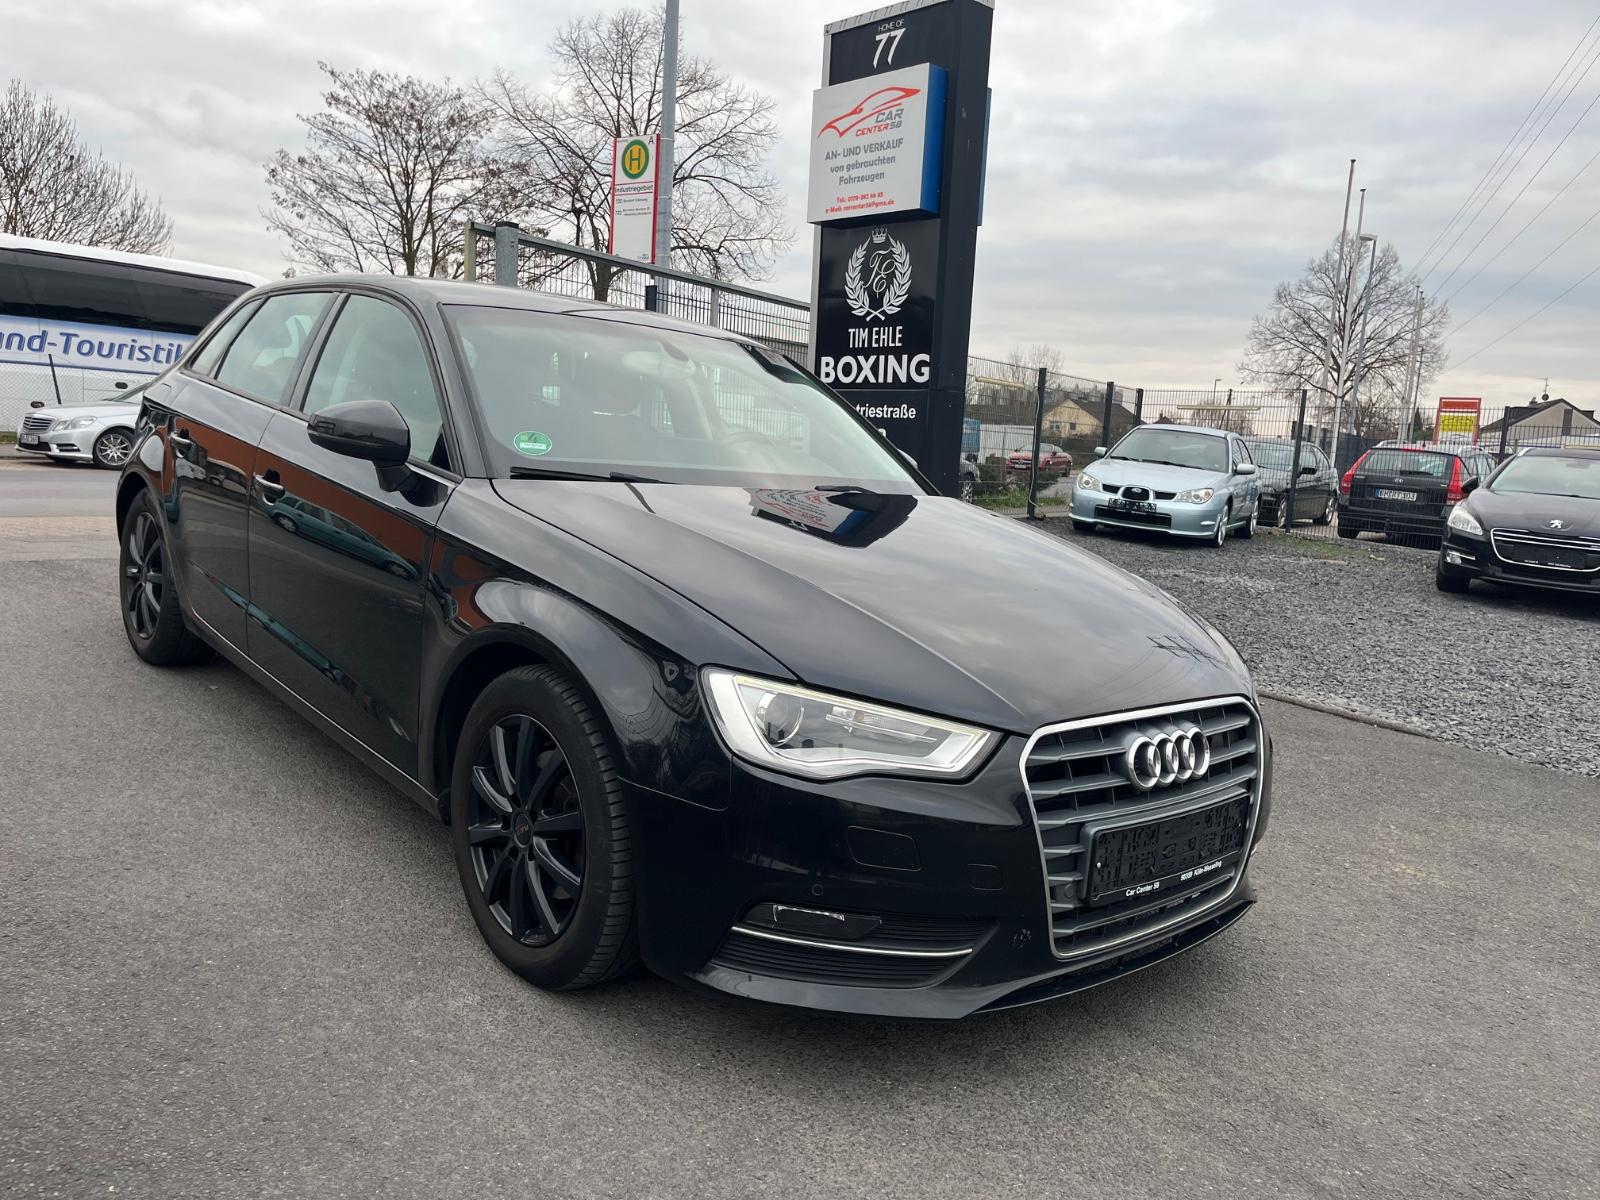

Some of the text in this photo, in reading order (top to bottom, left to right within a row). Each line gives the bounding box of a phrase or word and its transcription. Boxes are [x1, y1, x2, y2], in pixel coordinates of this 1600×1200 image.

[879, 18, 905, 32] HOME OF
[872, 28, 906, 69] 77
[875, 108, 905, 124] CAR
[648, 135, 655, 145] A
[824, 137, 904, 161] AN- UND VERKAUF
[629, 148, 642, 171] H
[830, 155, 896, 173] von gebrauchten
[838, 172, 885, 186] Fahrzeugen
[848, 325, 903, 349] TIM EHLE
[820, 353, 931, 384] BOXING
[1136, 884, 1154, 895] Center
[1154, 881, 1160, 890] 58
